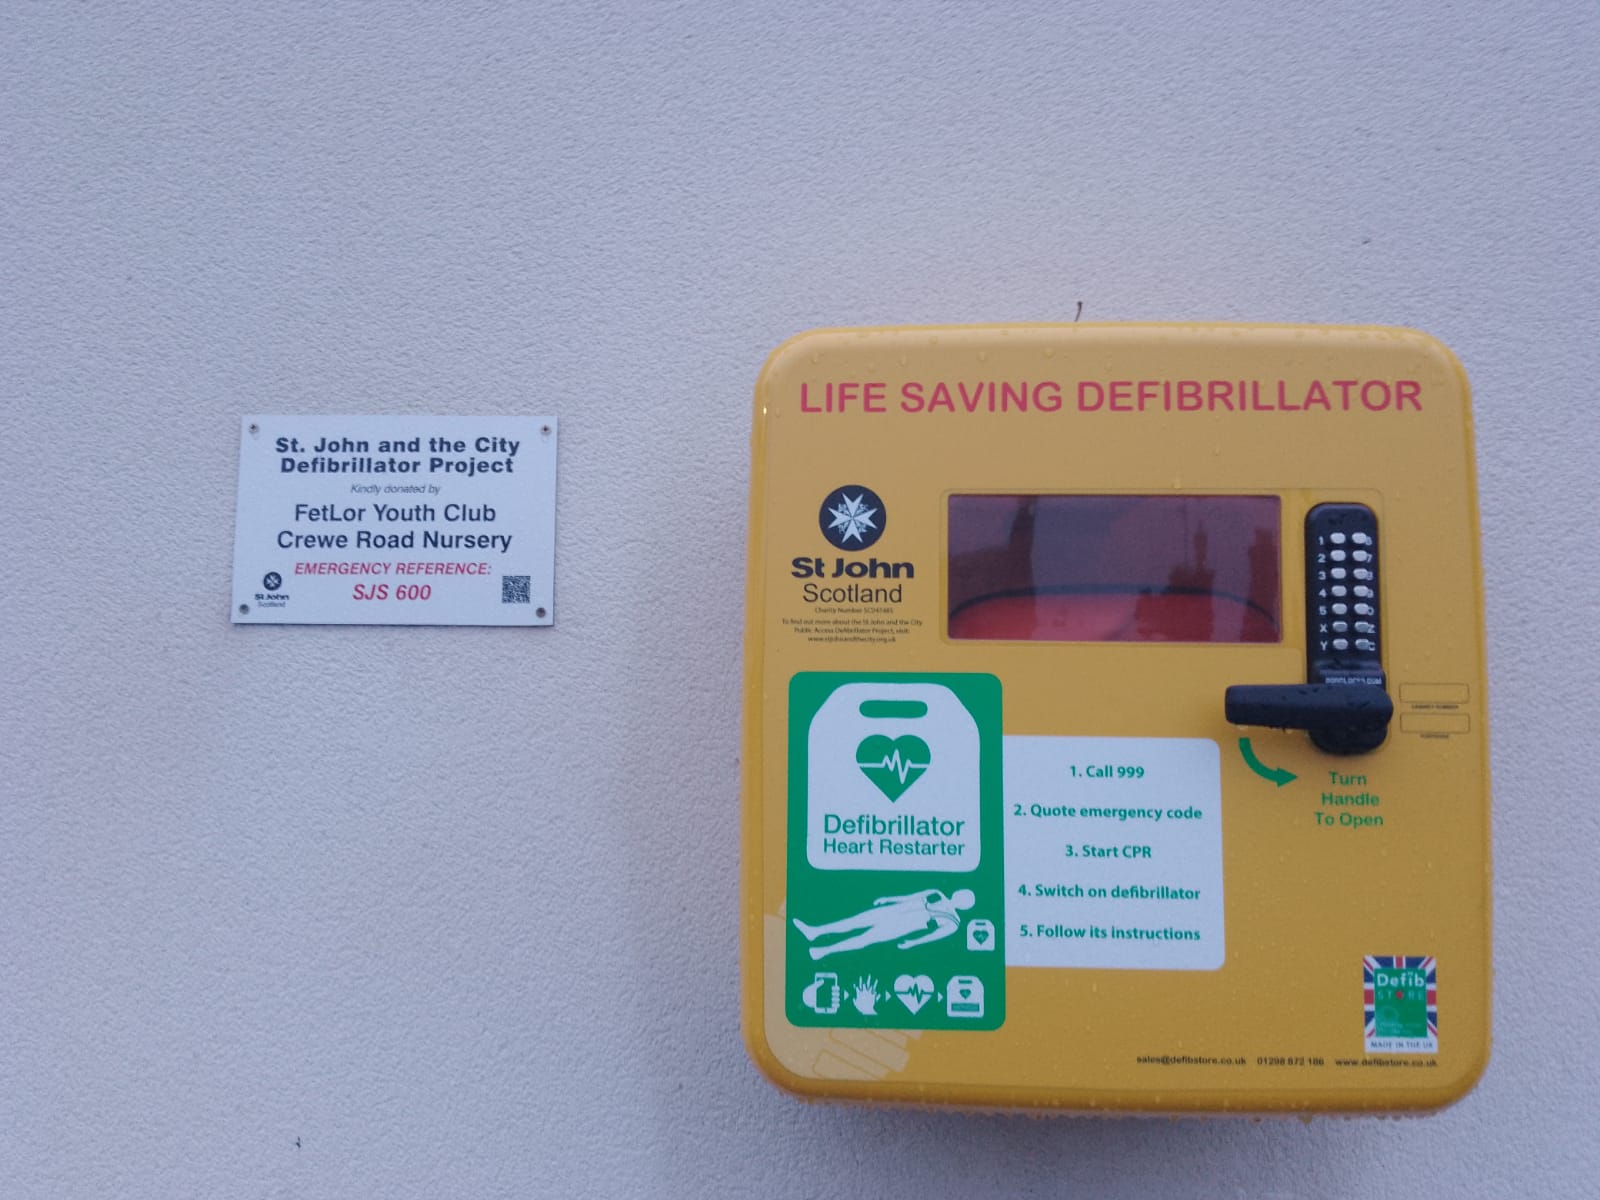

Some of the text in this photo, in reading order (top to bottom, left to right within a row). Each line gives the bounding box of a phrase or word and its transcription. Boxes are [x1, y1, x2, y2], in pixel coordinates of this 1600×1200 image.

[800, 380, 1423, 413] LIFE SAVING DEFIBRILLATOR
[275, 437, 520, 457] St. John and the City
[281, 457, 514, 477] Defibrillator Project
[350, 483, 441, 497] Kindly donated by
[295, 504, 496, 523] FetLor Youth Club
[277, 530, 512, 554] Crewe Road Nursery
[1318, 553, 1326, 563] 2
[294, 562, 491, 575] EMERGENCY REFERENCE:
[791, 557, 915, 579] St John
[1318, 571, 1326, 580] 3
[353, 584, 432, 601] SJS 600
[802, 583, 902, 604] Scotland
[1318, 588, 1327, 598] 4
[1319, 606, 1327, 615] 5
[1320, 624, 1328, 633] X
[1320, 641, 1328, 651] Y
[1070, 765, 1145, 778] 1. Call 999
[1329, 771, 1367, 787] Turn
[1322, 792, 1380, 806] Handle
[1013, 804, 1203, 821] 2. Quote emergency code
[823, 814, 965, 837] Defibrillator
[1315, 813, 1384, 829] To Open
[823, 838, 965, 857] Heart Restarter
[1065, 845, 1152, 858] 3. Start CPR
[1018, 884, 1201, 900] 4. Switch on defibrillator
[1019, 924, 1201, 940] 5. Follow its instructions
[1376, 971, 1425, 987] Defib
[1371, 1041, 1391, 1049] MADE
[1407, 1041, 1420, 1049] THE
